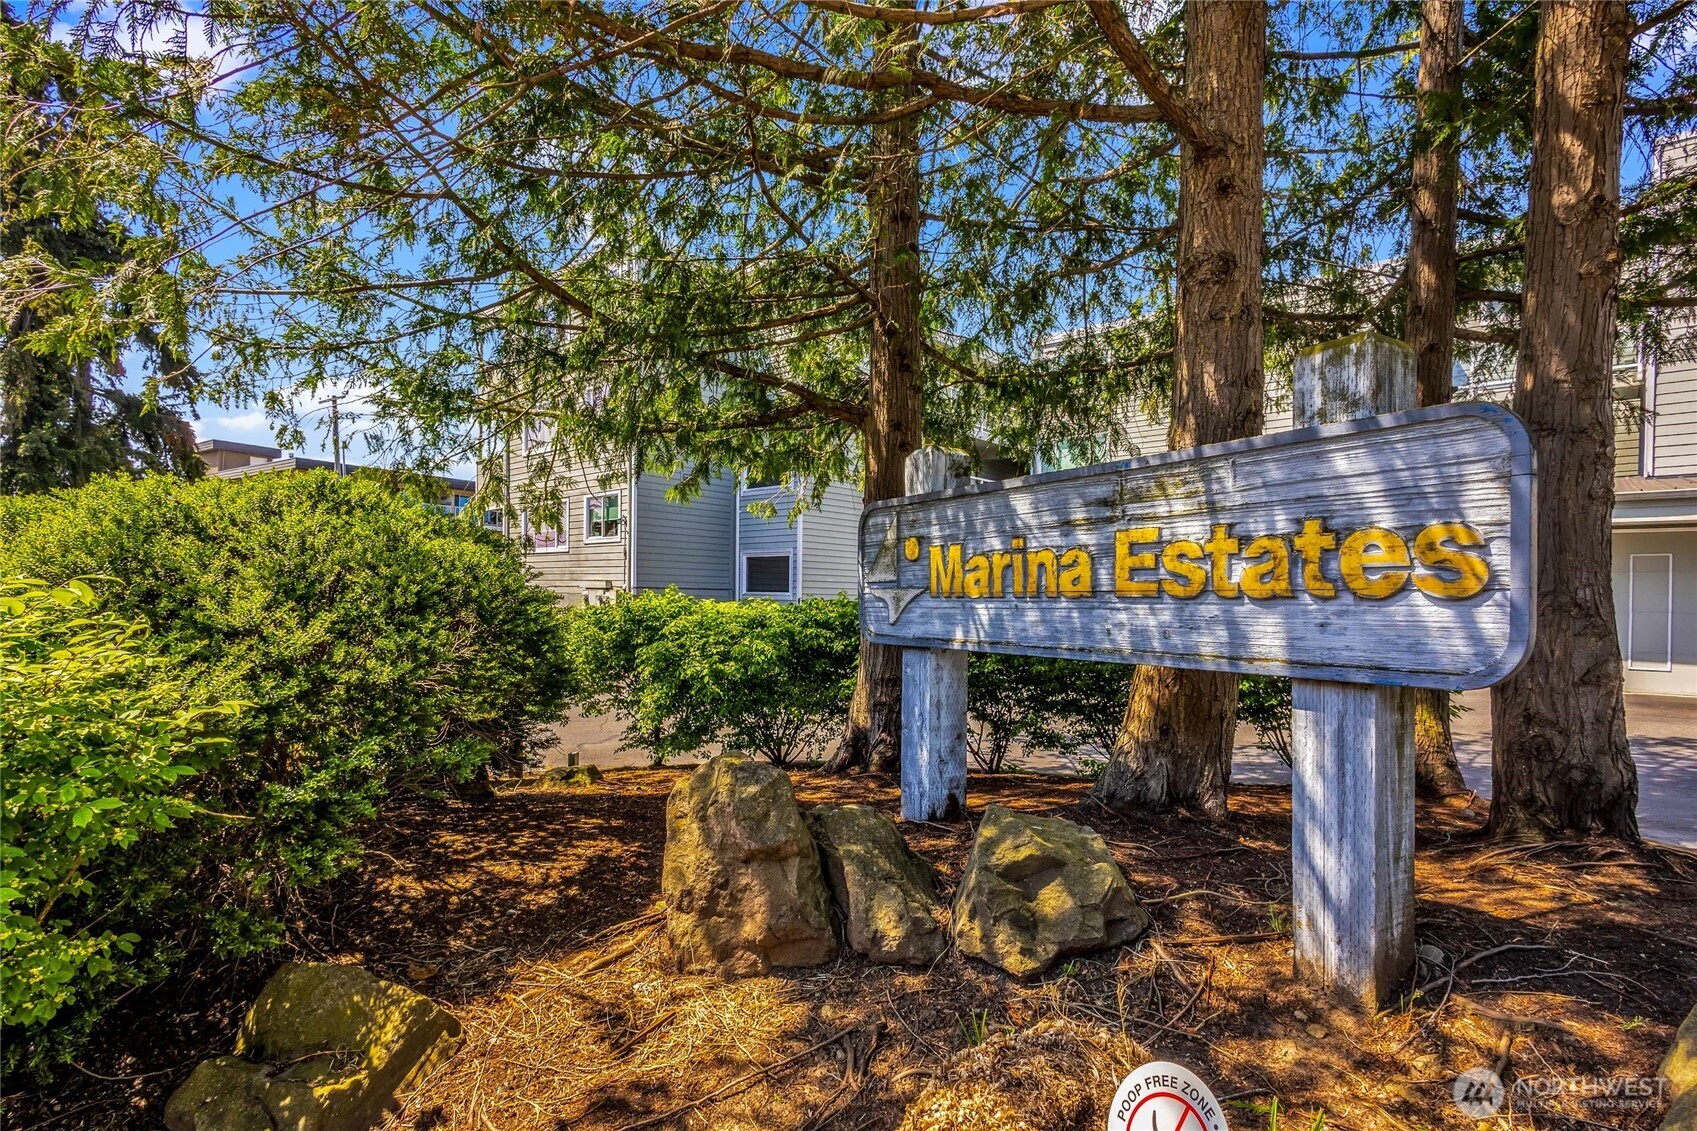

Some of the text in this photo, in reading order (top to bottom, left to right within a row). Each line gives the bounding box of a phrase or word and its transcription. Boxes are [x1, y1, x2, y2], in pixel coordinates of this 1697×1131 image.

[929, 517, 1491, 600] Marina Estates
[1117, 1074, 1216, 1122] POOP FREE ZONE
